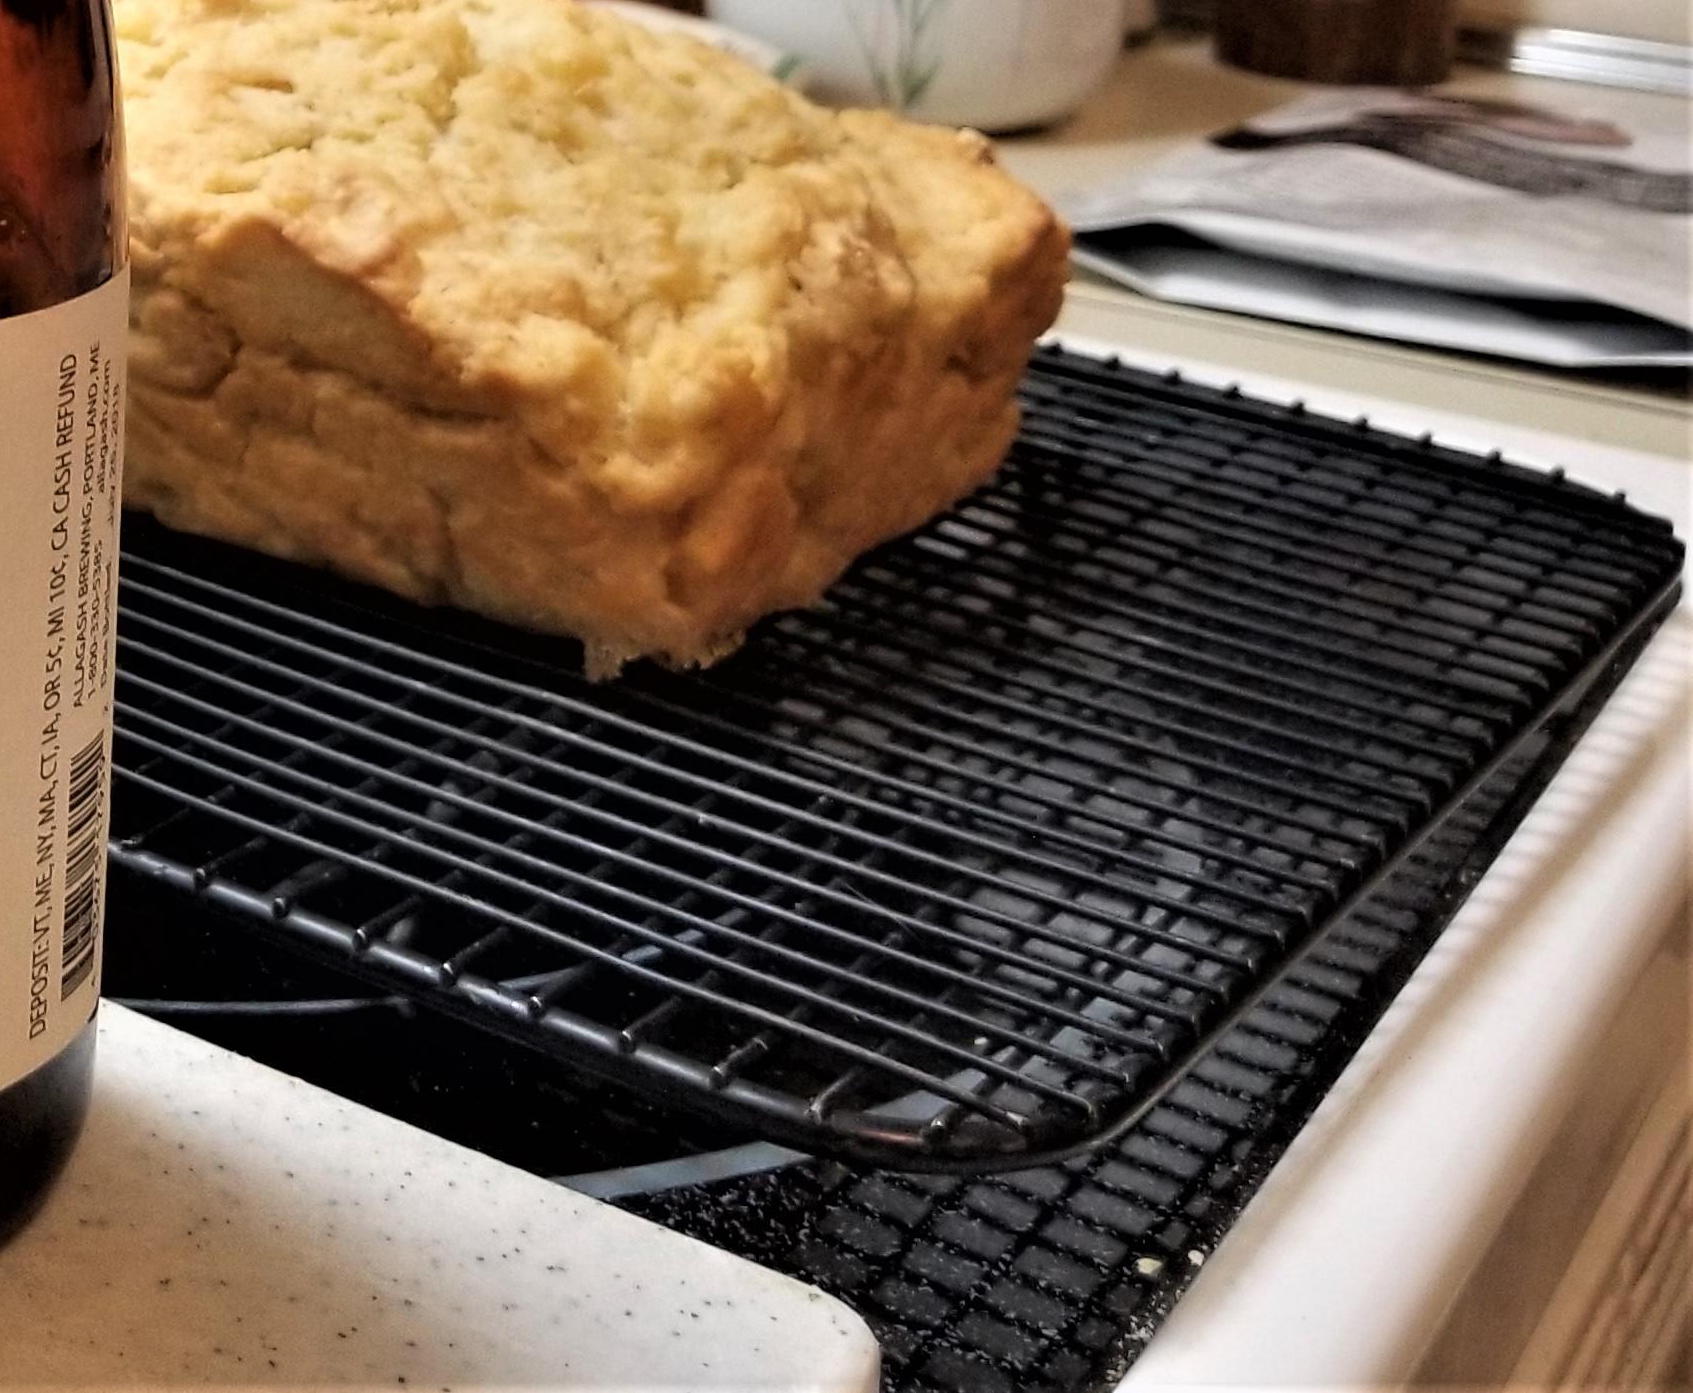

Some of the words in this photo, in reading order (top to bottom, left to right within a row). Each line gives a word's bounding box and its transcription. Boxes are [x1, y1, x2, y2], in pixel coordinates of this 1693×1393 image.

[56, 354, 77, 447] REFUND
[89, 338, 100, 375] ME
[83, 376, 100, 494] PORTLAND,
[52, 451, 72, 514] CASH
[88, 539, 102, 699] 1-800-330-5385
[97, 359, 110, 494] allagash.com
[51, 516, 69, 551] CA
[78, 495, 94, 597] BREWING,
[47, 606, 65, 637] MI
[73, 603, 88, 708] ALLAGASH
[43, 674, 62, 711] OR
[29, 943, 50, 1040] DEPOSIT:
